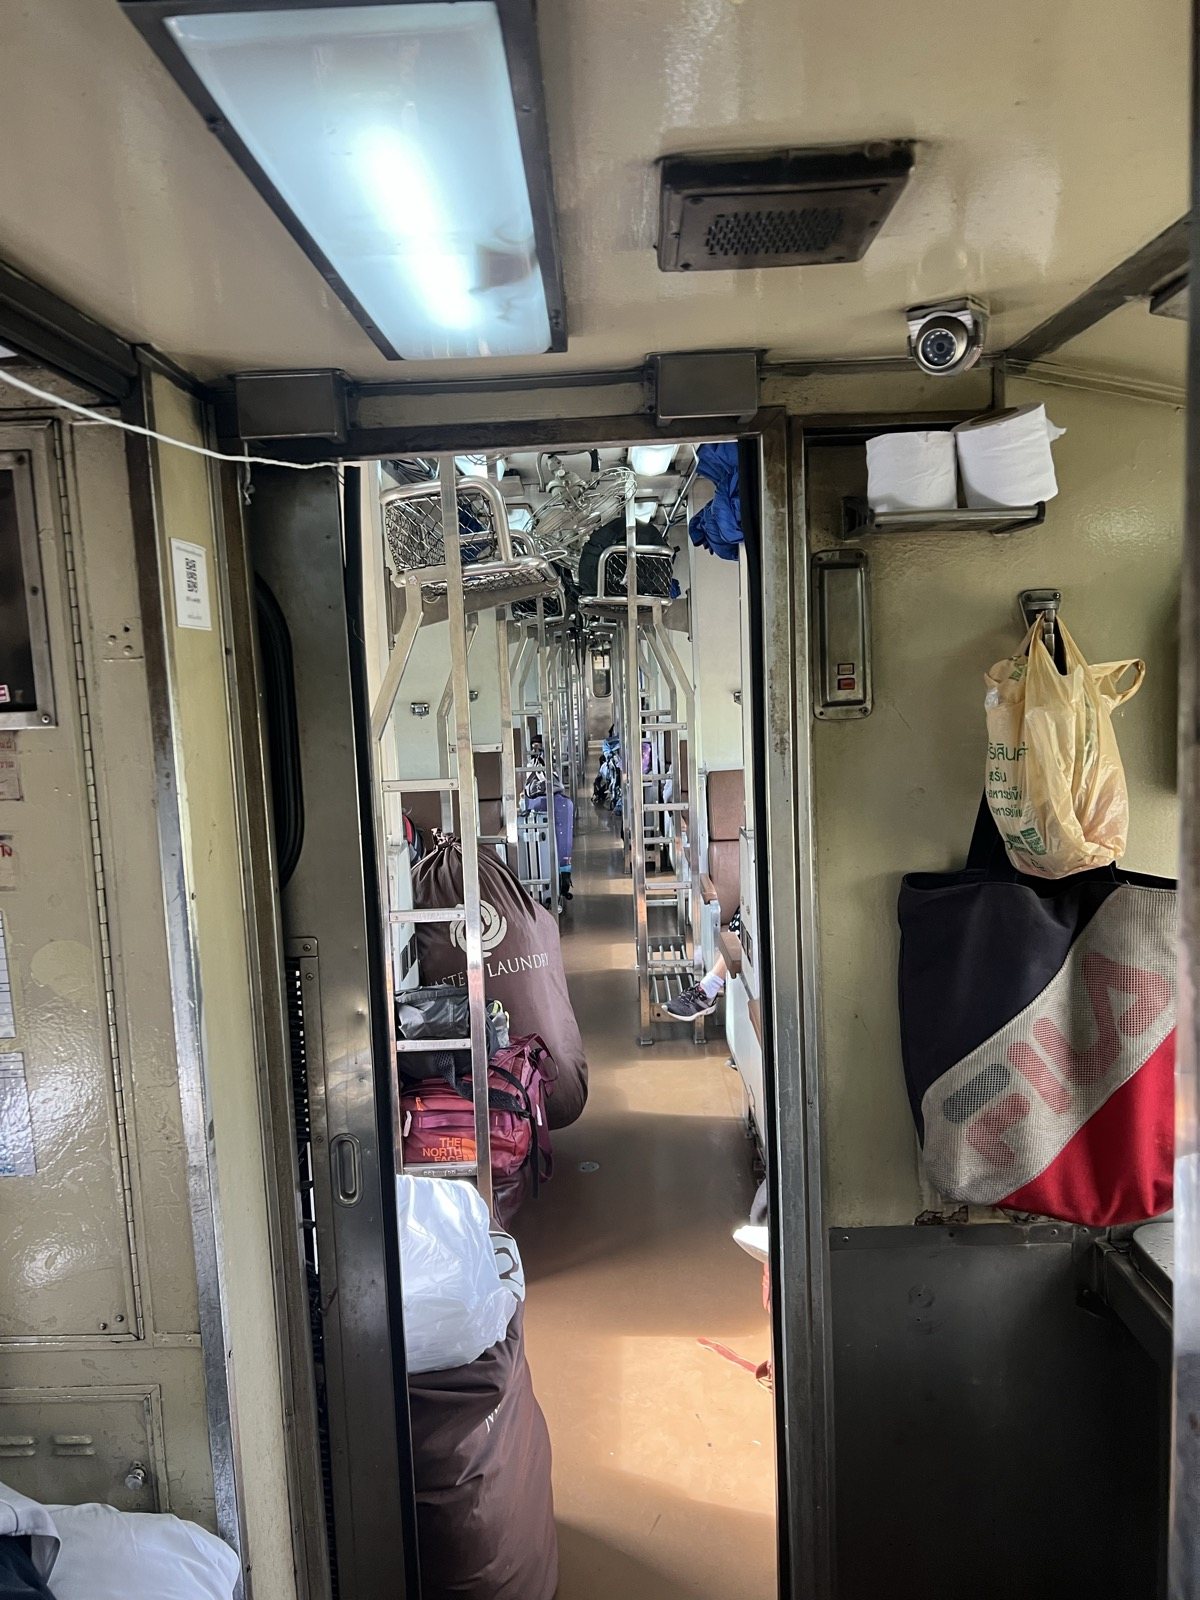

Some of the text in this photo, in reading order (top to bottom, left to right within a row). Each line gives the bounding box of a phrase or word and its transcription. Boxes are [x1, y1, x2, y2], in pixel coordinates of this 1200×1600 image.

[943, 952, 1173, 1168] FILA
[439, 1137, 462, 1148] THE
[422, 1146, 463, 1157] NORTH
